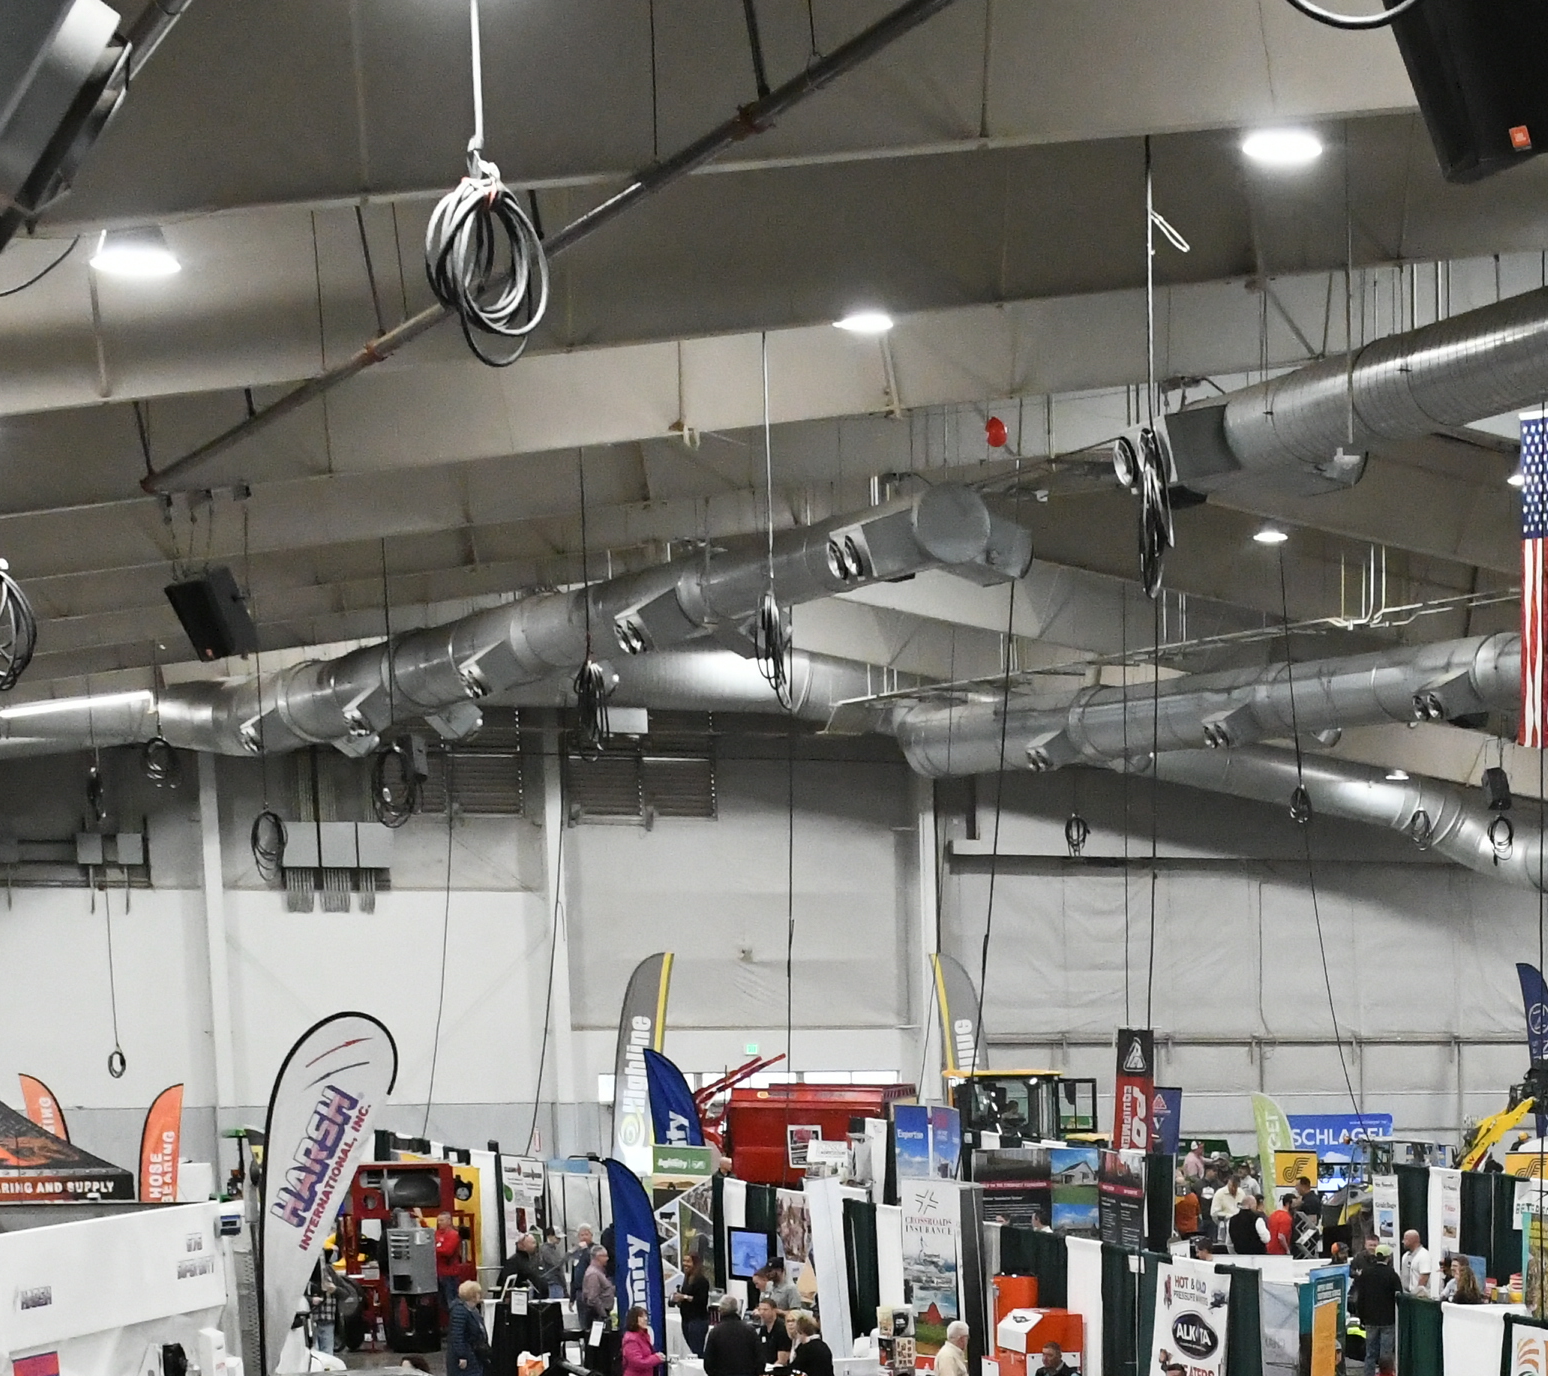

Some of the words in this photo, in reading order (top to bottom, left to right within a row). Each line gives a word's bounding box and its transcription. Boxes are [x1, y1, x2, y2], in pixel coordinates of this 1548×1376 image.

[622, 1015, 651, 1114] Highline
[149, 1153, 162, 1200] HOSE
[36, 1182, 63, 1194] AND
[67, 1181, 115, 1194] SUPPLY
[905, 1217, 952, 1226] CROSSROADS
[905, 1225, 952, 1236] INSURANCE
[1175, 1276, 1188, 1289] HOT
